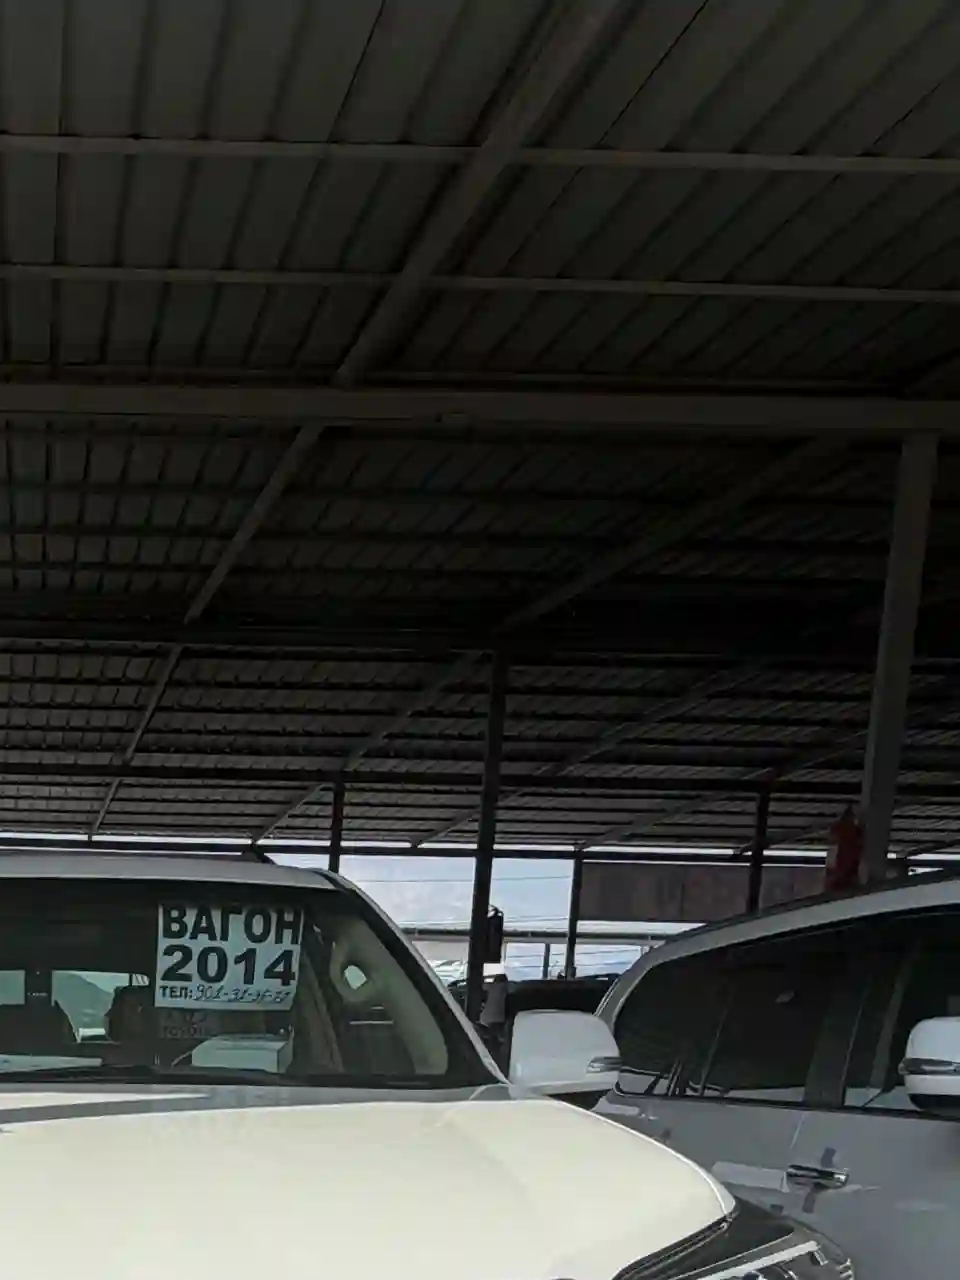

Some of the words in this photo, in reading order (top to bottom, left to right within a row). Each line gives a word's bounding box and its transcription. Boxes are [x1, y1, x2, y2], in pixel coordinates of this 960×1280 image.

[162, 906, 301, 944] ВАГОН
[161, 944, 296, 986] 2014
[159, 985, 194, 999] ТЕЛ:
